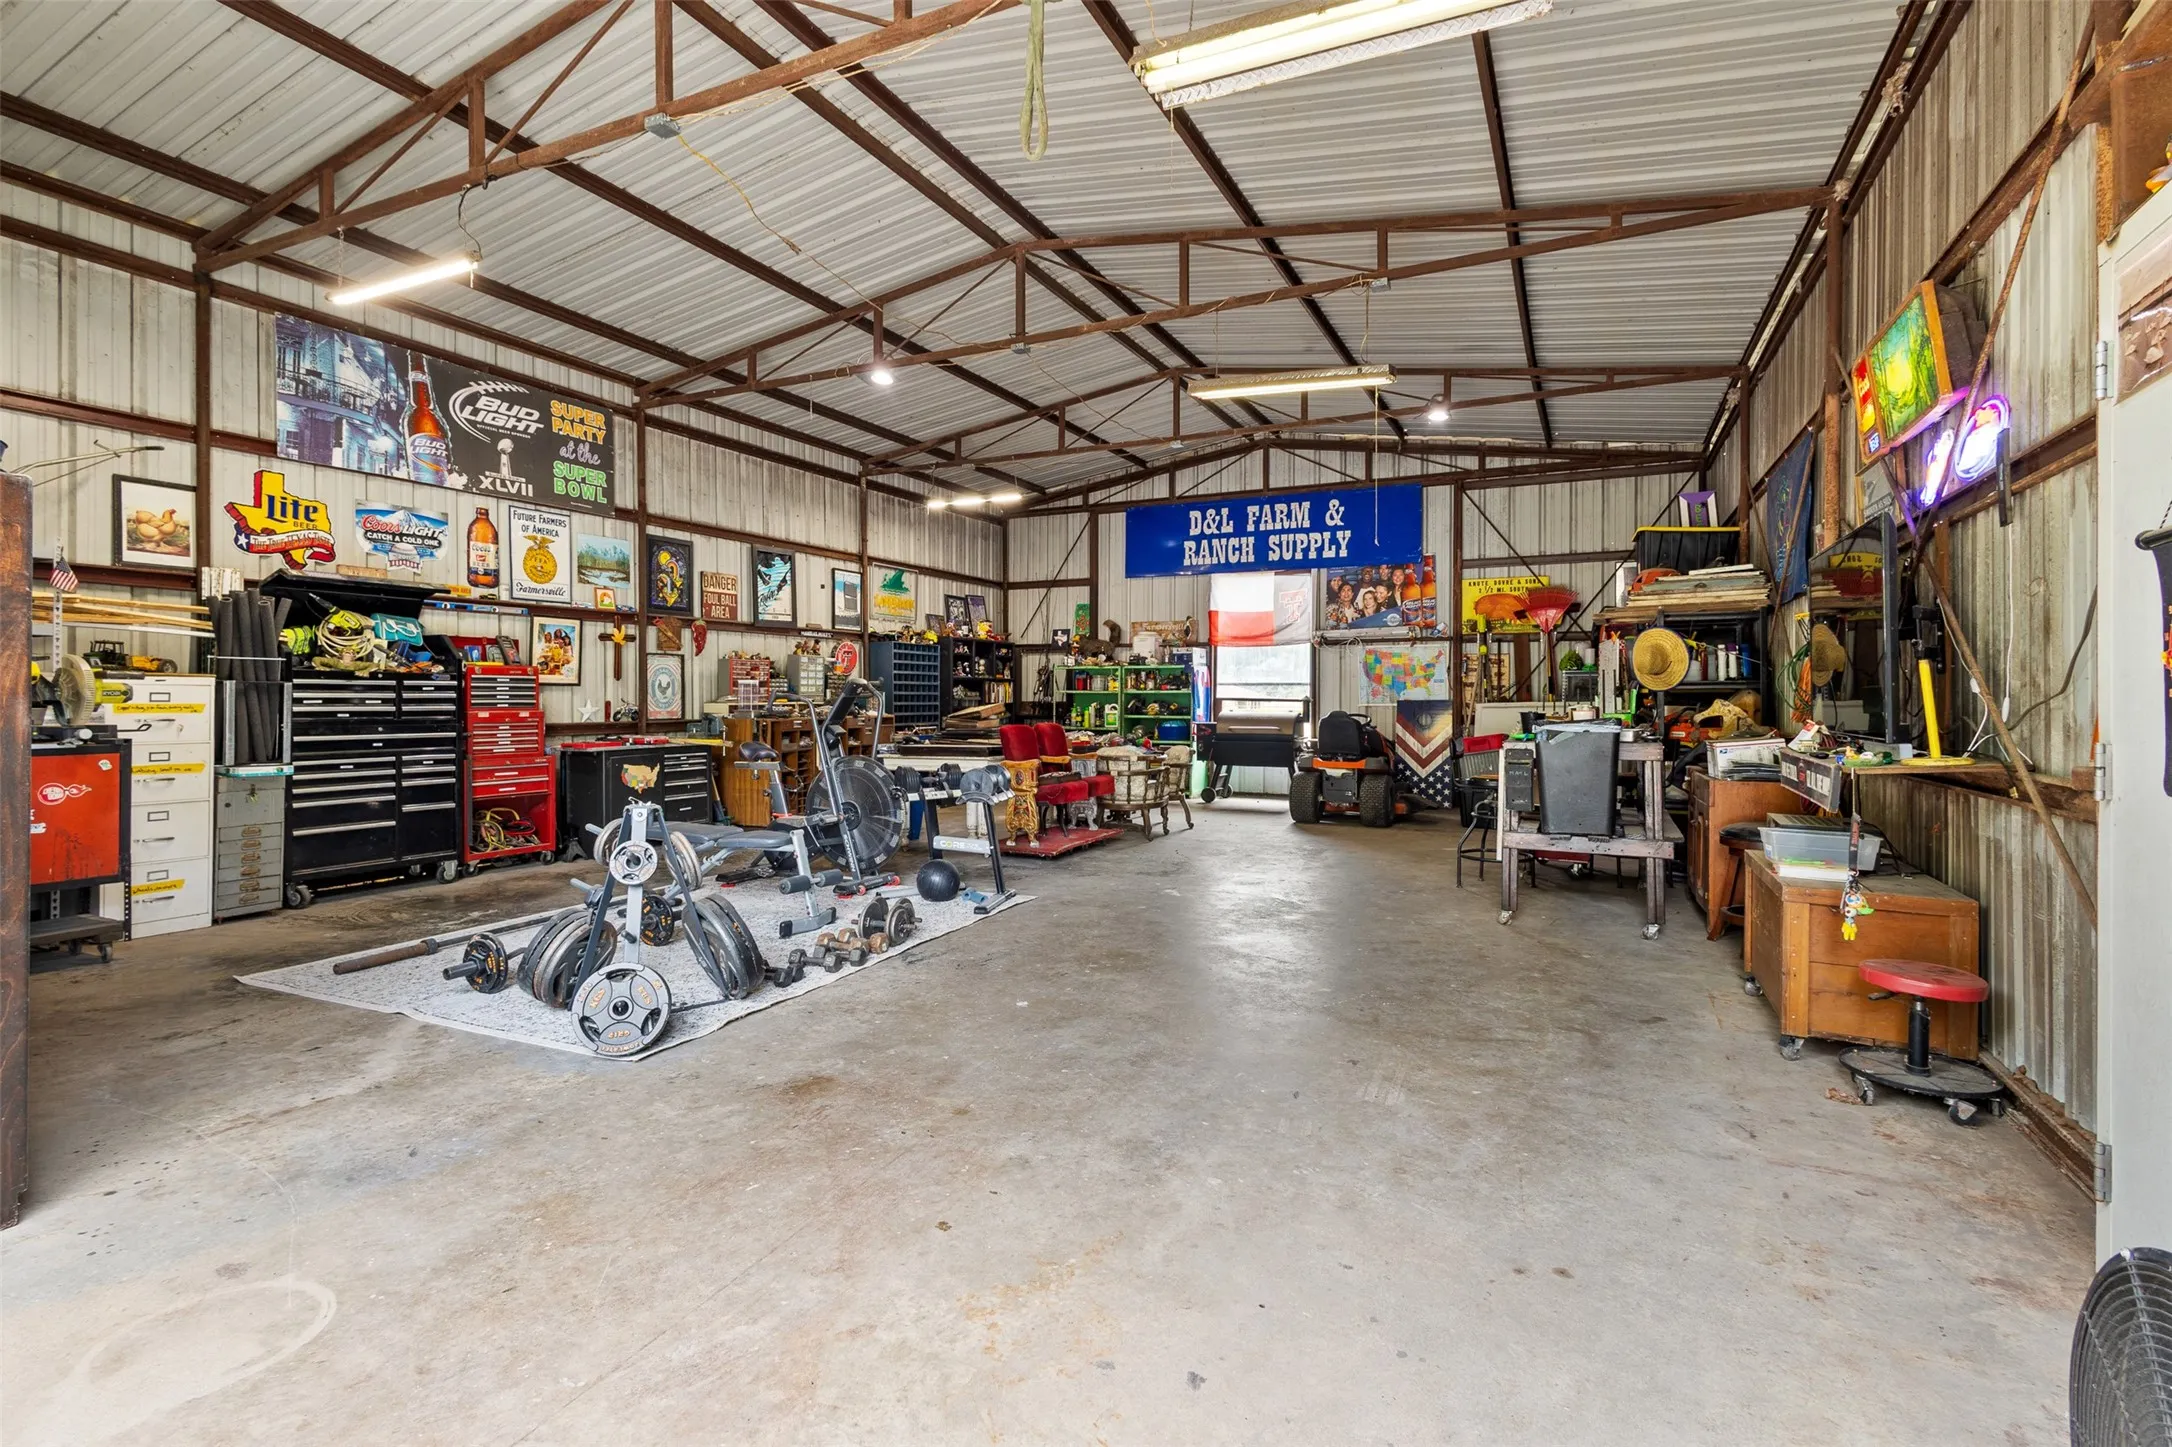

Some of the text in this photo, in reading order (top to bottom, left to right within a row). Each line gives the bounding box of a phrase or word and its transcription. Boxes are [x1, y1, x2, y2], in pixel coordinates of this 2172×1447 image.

[460, 405, 545, 434] LIGHT
[475, 396, 540, 421] BUD
[550, 400, 606, 429] SUPER
[551, 416, 606, 445] PARTY
[410, 446, 448, 457] LIGHT
[414, 439, 446, 449] BUD
[559, 440, 601, 465] at the
[553, 460, 607, 487] SUPER
[478, 475, 533, 497] XLVII
[554, 477, 607, 504] BOWL
[264, 494, 318, 523] Lite
[1188, 498, 1344, 536] D&L FARM &
[293, 521, 318, 529] BEER
[361, 514, 442, 538] Coors LIGHT
[521, 524, 529, 533] OF
[366, 532, 393, 541] CATCH
[402, 536, 422, 545] COLD
[423, 539, 440, 547] ONE
[1183, 530, 1351, 566] RANCH SUPPLY
[515, 581, 566, 597] Farmersville
[703, 574, 737, 591] DANGER
[703, 593, 736, 607] FOUL BALL
[711, 605, 730, 619] AREA
[843, 834, 857, 872] SCHWINN
[940, 840, 965, 849] CORE
[608, 1030, 631, 1040] GRIP
